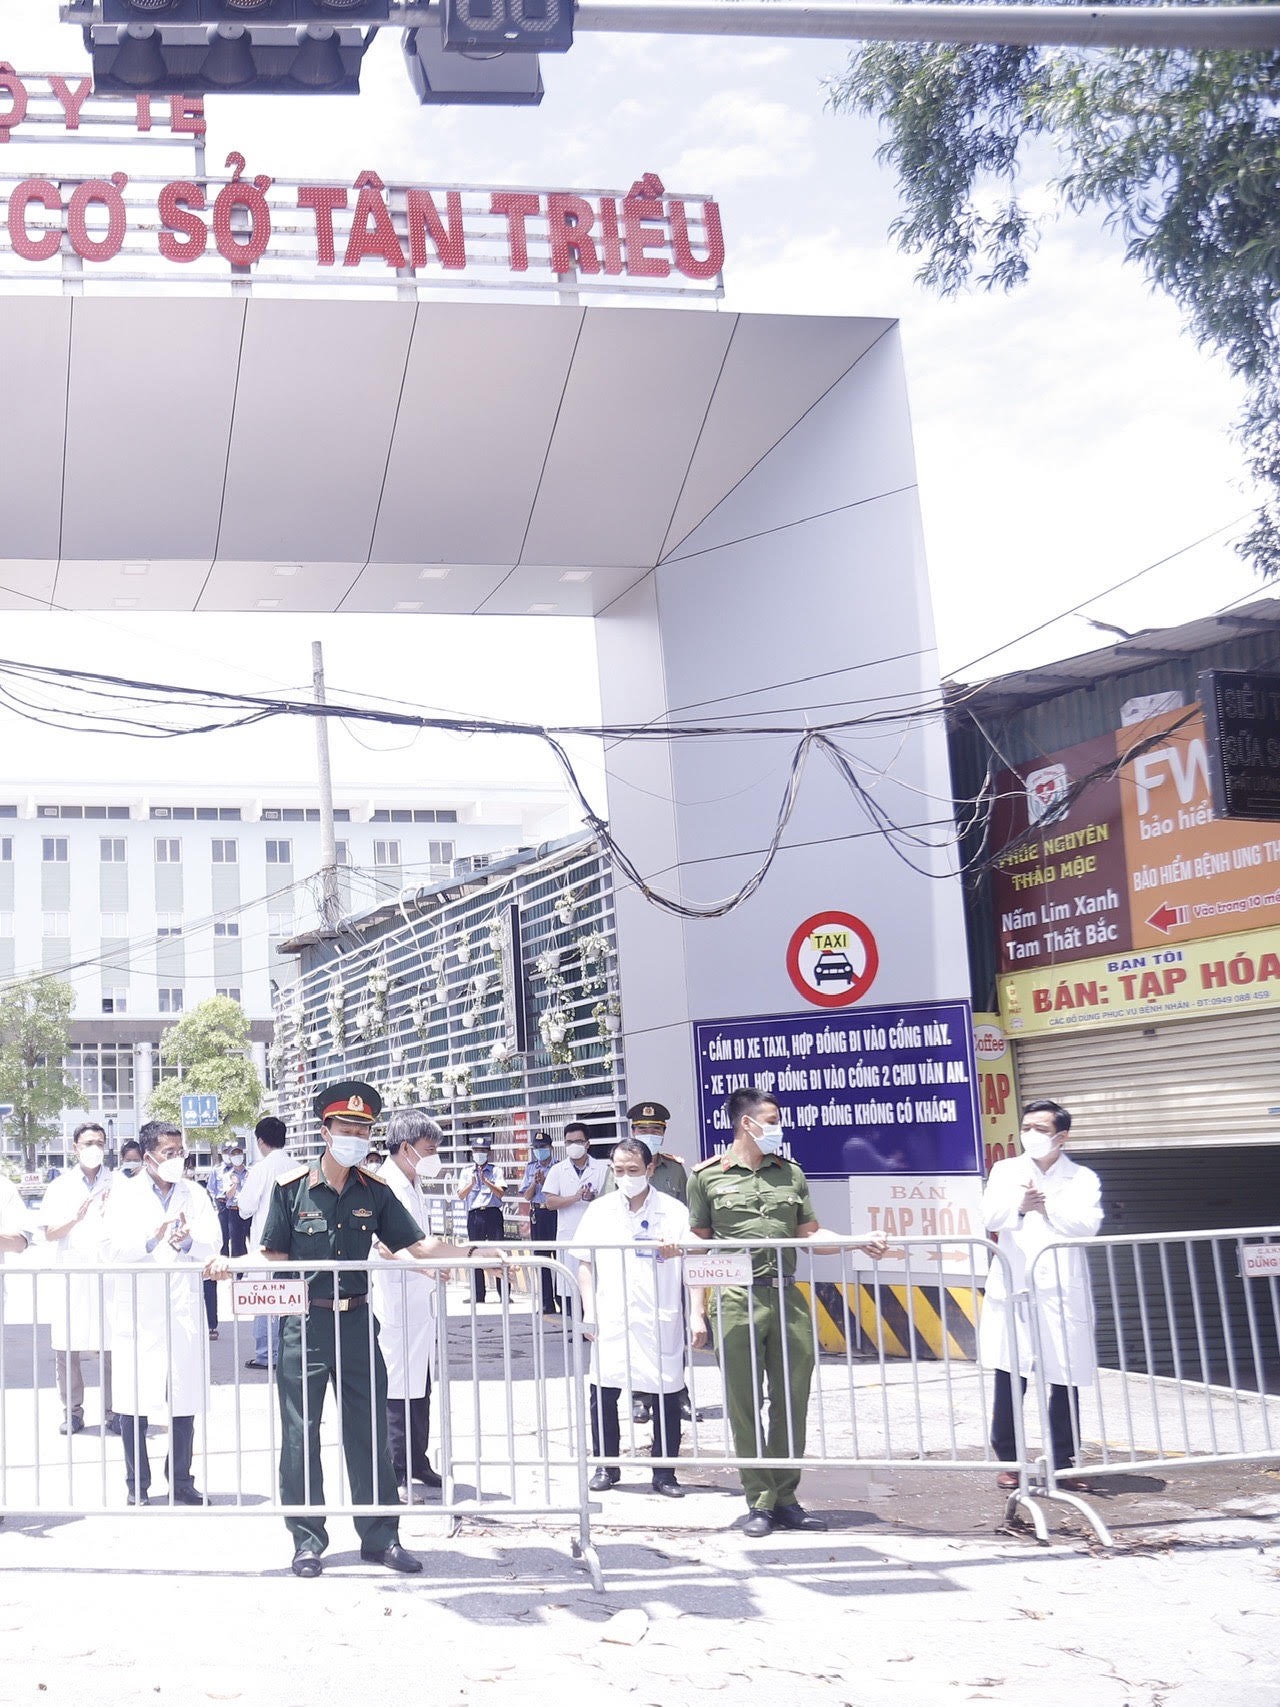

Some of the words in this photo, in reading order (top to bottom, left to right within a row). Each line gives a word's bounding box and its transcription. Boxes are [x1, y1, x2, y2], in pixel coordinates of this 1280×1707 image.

[48, 76, 93, 130] Y
[8, 171, 128, 262] CƠ
[157, 151, 271, 265] SỞ
[297, 170, 467, 269] TÂN
[1043, 823, 1109, 857] NGUYÊN
[1139, 815, 1174, 841] bảo
[1060, 855, 1097, 880] MỘC
[1133, 864, 1157, 891] BẢO
[1194, 853, 1231, 880] BỆNH
[1233, 845, 1261, 869] UNG
[1001, 908, 1037, 932] Nấm
[1041, 902, 1070, 925] Lim
[1074, 887, 1119, 917] Xanh
[1193, 905, 1215, 917] Vào
[1218, 901, 1246, 915] trong
[1249, 894, 1261, 907] 10
[814, 934, 847, 949] TAXI
[1006, 938, 1040, 961] Tam
[1043, 926, 1082, 953] Thất
[1086, 916, 1118, 945] Bắc
[1108, 957, 1146, 973] BẠN
[1152, 950, 1183, 965] TÔI
[1032, 980, 1109, 1014] BÁN:
[1117, 967, 1187, 1003] TẠP
[1199, 951, 1280, 989] HÓA
[709, 1033, 732, 1061] CẤM
[734, 1038, 745, 1059] ĐI
[747, 1037, 761, 1059] XE
[762, 1035, 790, 1058] TAXI,
[792, 1031, 813, 1060] HỢP
[816, 1025, 847, 1054] ĐỒNG
[849, 1030, 861, 1052] ĐI
[862, 1024, 886, 1051] VÀO
[888, 1018, 922, 1050] CỔNG
[923, 1019, 952, 1047] NÀY.
[711, 1074, 724, 1095] XE
[778, 1064, 808, 1092] ĐỒNG
[809, 1069, 821, 1090] ĐI
[823, 1064, 846, 1089] VÀO
[848, 1058, 880, 1088] CỔNG
[882, 1065, 891, 1087] 2
[892, 1063, 917, 1086] CHU
[918, 1058, 945, 1085] VĂN
[946, 1060, 969, 1083] AN.
[797, 1104, 819, 1131] HỢP
[821, 1097, 853, 1126] ĐỒNG
[854, 1097, 895, 1125] KHÔNG
[896, 1096, 913, 1124] CÓ
[915, 1095, 957, 1123] KHÁCH
[890, 1181, 948, 1200] BÁN
[238, 1292, 276, 1305] DỪNG
[279, 1294, 301, 1306] LẠI
